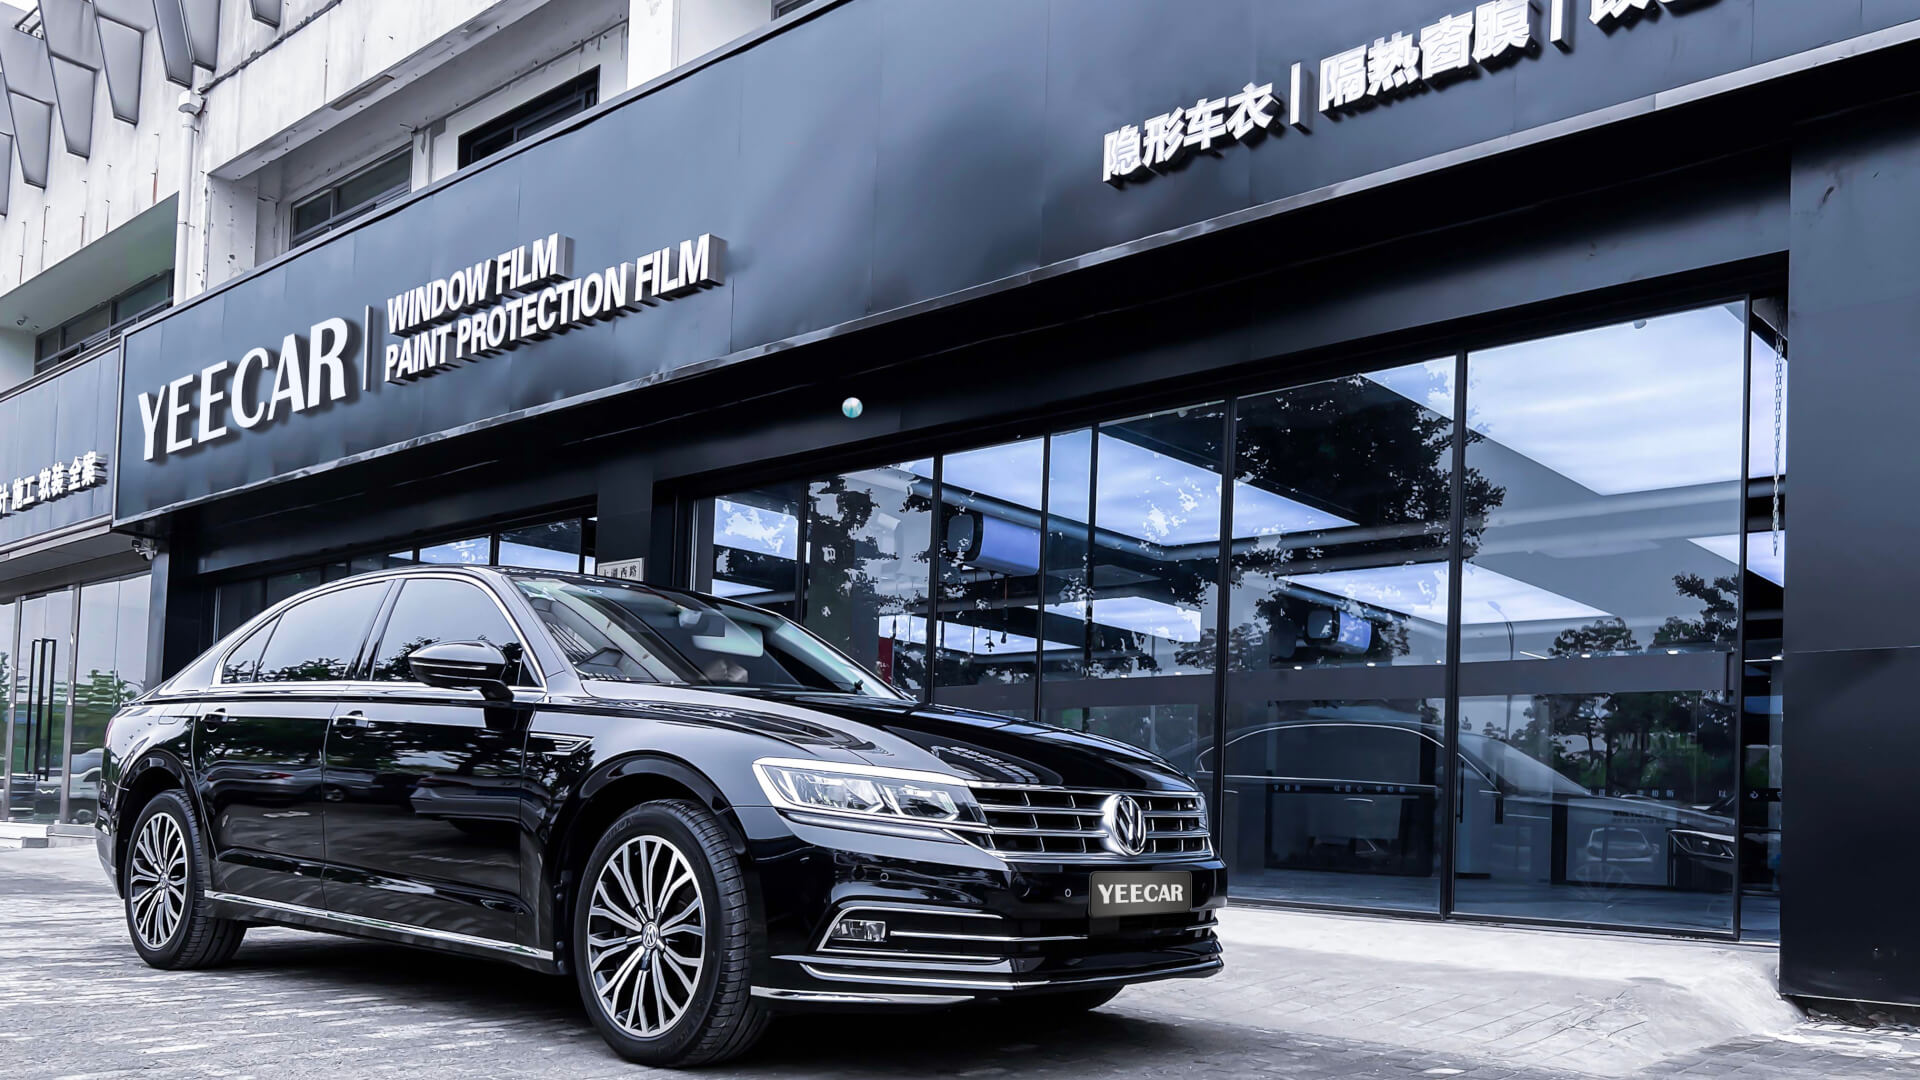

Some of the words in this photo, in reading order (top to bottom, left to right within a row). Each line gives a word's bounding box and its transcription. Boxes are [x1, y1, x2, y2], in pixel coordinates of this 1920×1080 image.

[1102, 82, 1274, 183] 隐形车衣
[1319, 0, 1531, 113] 隔热窗膜
[384, 323, 453, 383] PAINT
[455, 261, 630, 359] PROTECTION
[634, 232, 711, 302] FILM
[387, 259, 492, 335] WINDOW
[495, 232, 560, 296] FILM
[137, 316, 349, 462] YEECAR
[1097, 884, 1184, 905] YEECAR
